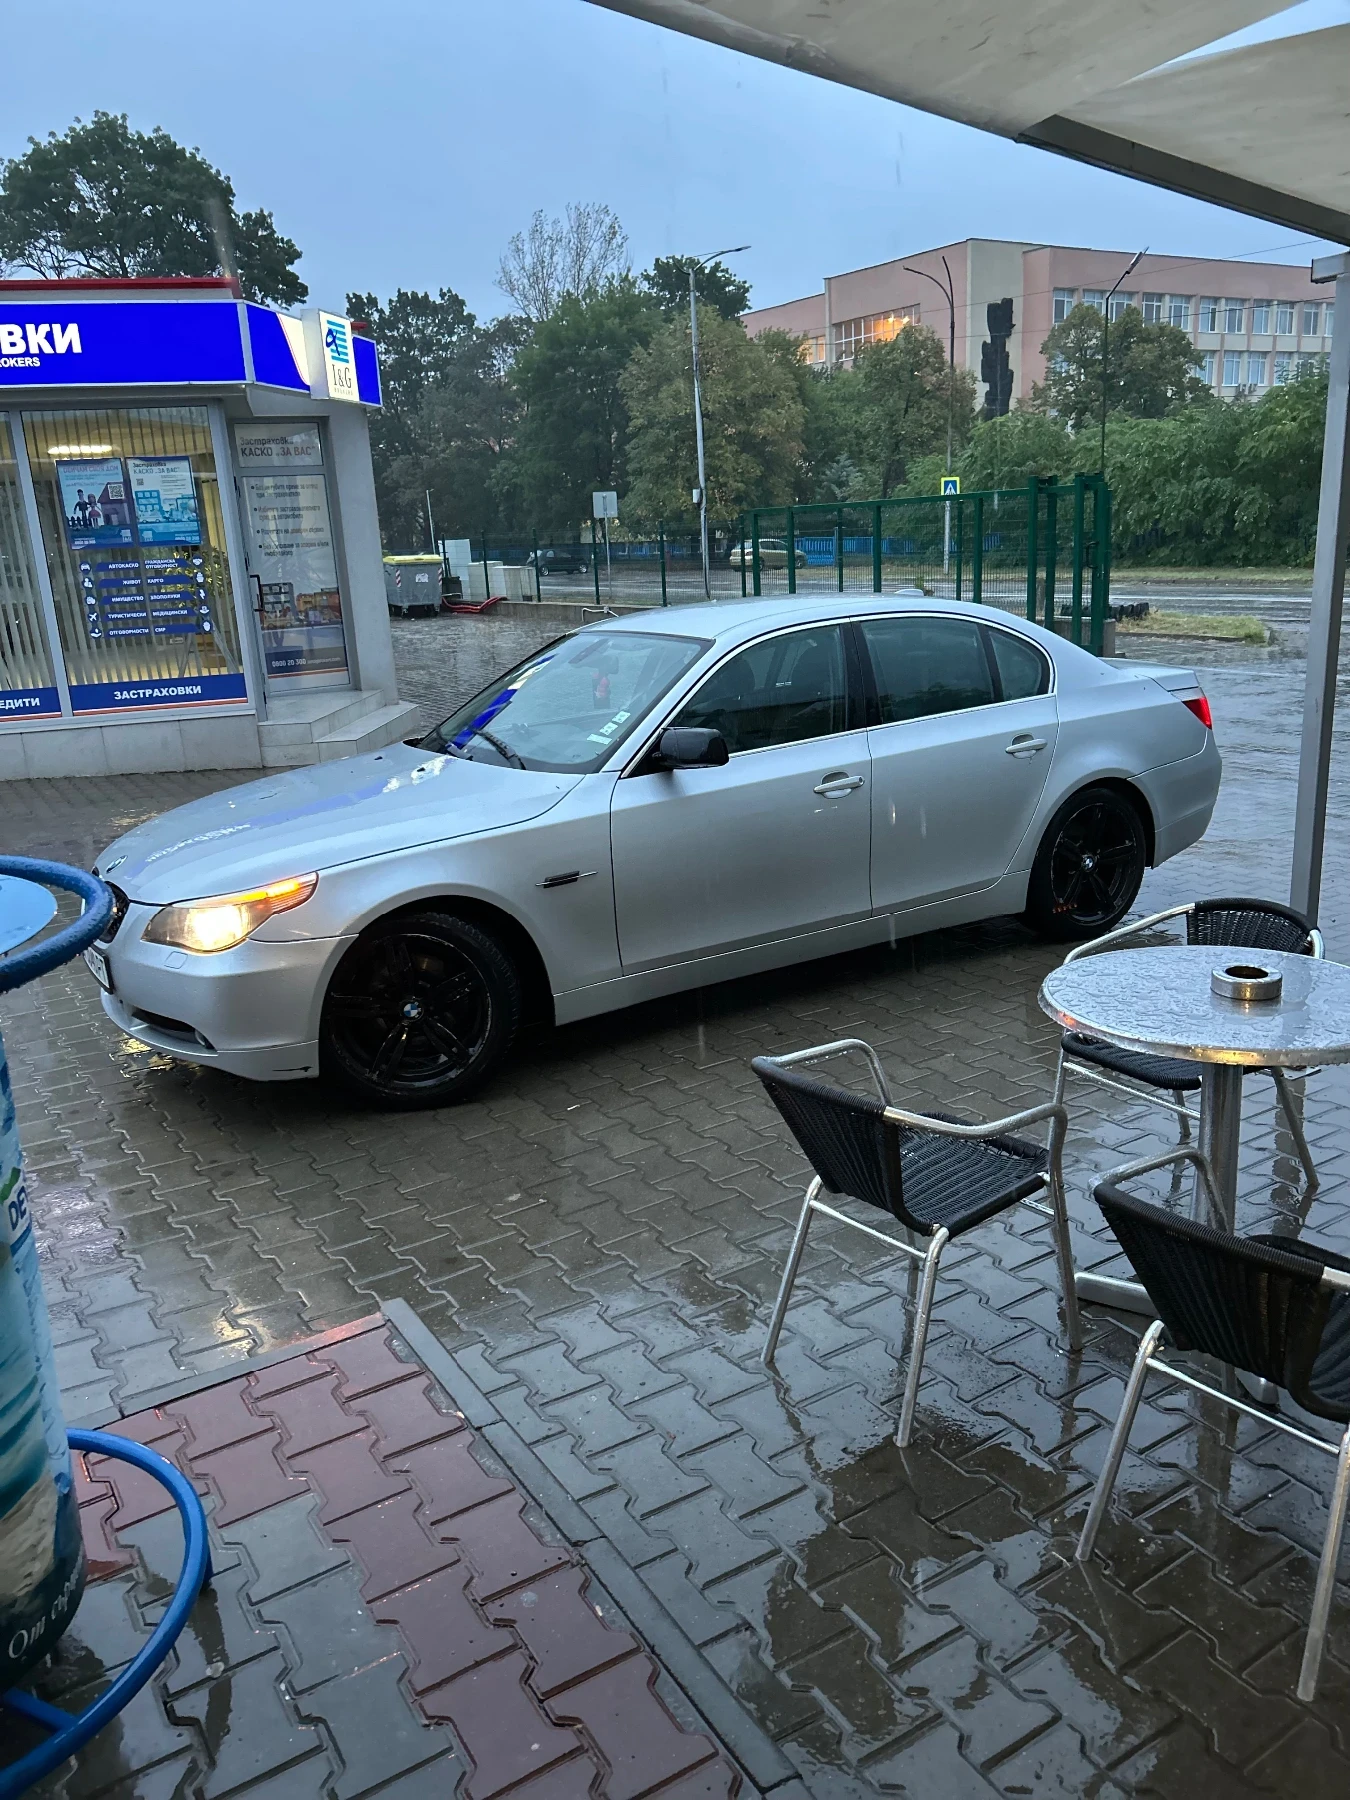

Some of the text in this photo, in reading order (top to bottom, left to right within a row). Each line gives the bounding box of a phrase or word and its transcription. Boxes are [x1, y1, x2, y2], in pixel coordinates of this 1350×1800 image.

[0, 323, 82, 354] ВКИ
[0, 357, 41, 368] OKERS
[332, 363, 352, 388] I&G
[240, 437, 294, 446] Застраховка
[241, 447, 273, 457] КАСКО
[152, 609, 188, 617] МЕДИЦИНСКИ
[109, 628, 149, 636] ОТГОВОРНОСТИ
[113, 685, 201, 700] ЗАСТРАХОВКИ
